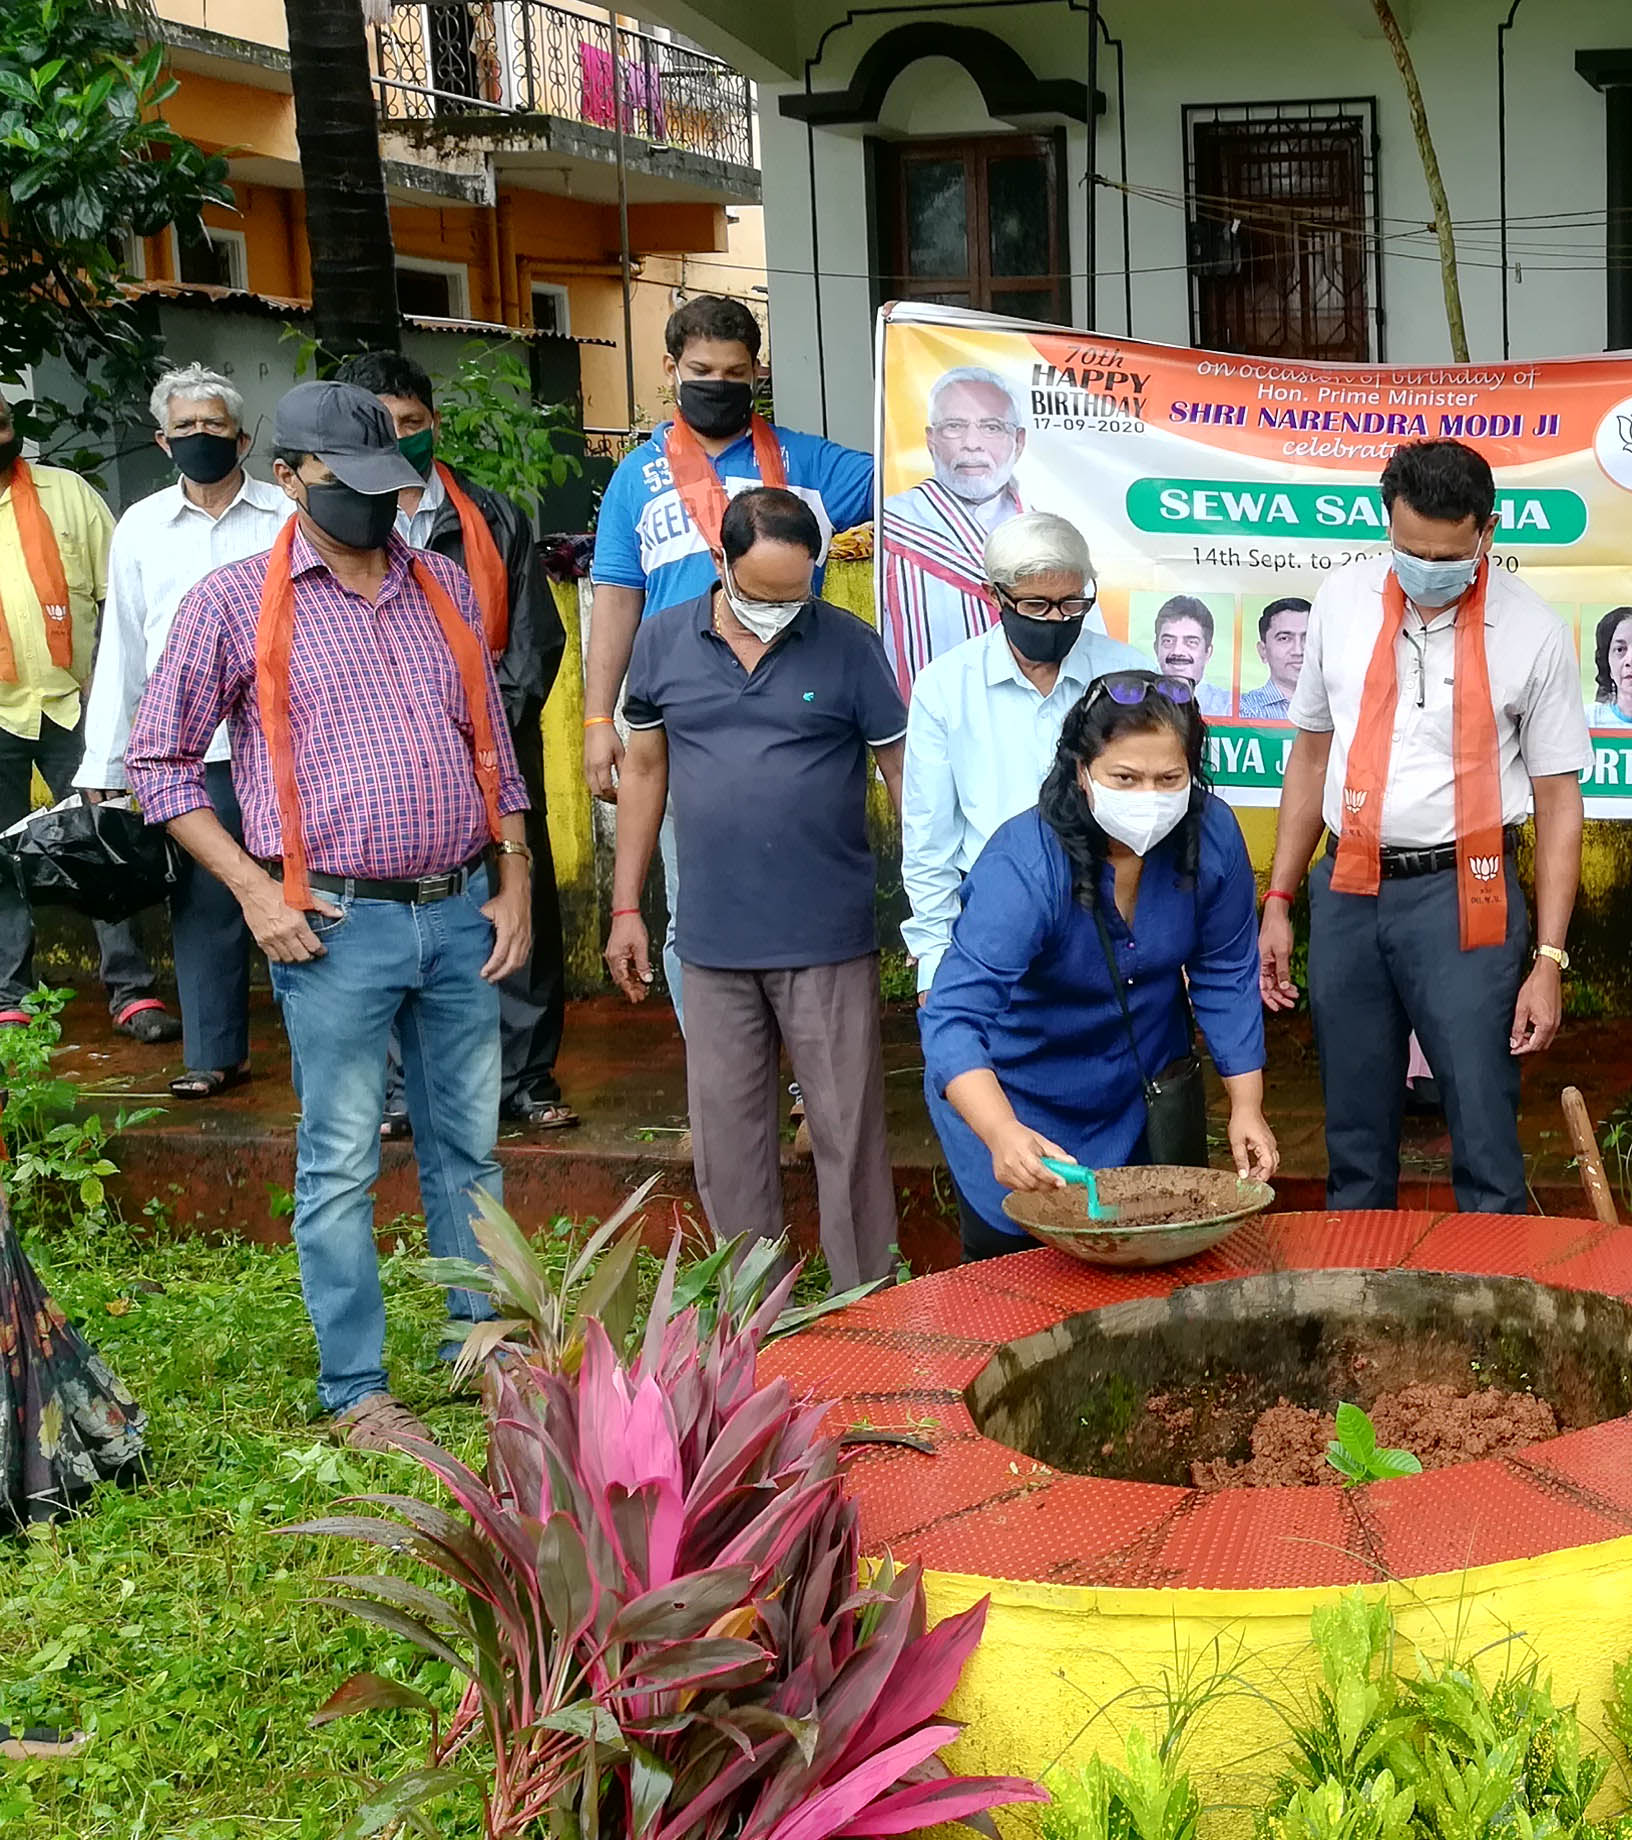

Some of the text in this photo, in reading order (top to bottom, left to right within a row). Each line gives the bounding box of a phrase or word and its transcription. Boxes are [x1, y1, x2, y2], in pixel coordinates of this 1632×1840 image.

[1065, 344, 1124, 368] 70th
[1031, 363, 1151, 393] HAPPY
[1197, 360, 1236, 376] on
[1391, 368, 1505, 390] birthday
[1513, 367, 1542, 389] of
[1031, 390, 1147, 418] BIRTHDAY
[1258, 383, 1478, 407] Hon. Prime Minister
[1034, 417, 1145, 433] 17-09-2020
[1169, 400, 1561, 438] SHRI NARENDRA MODI JI
[642, 456, 674, 493] 53
[1159, 488, 1300, 524] SEWA
[1193, 547, 1241, 567] 14th
[1249, 549, 1302, 572] Sept.
[1311, 553, 1332, 569] to
